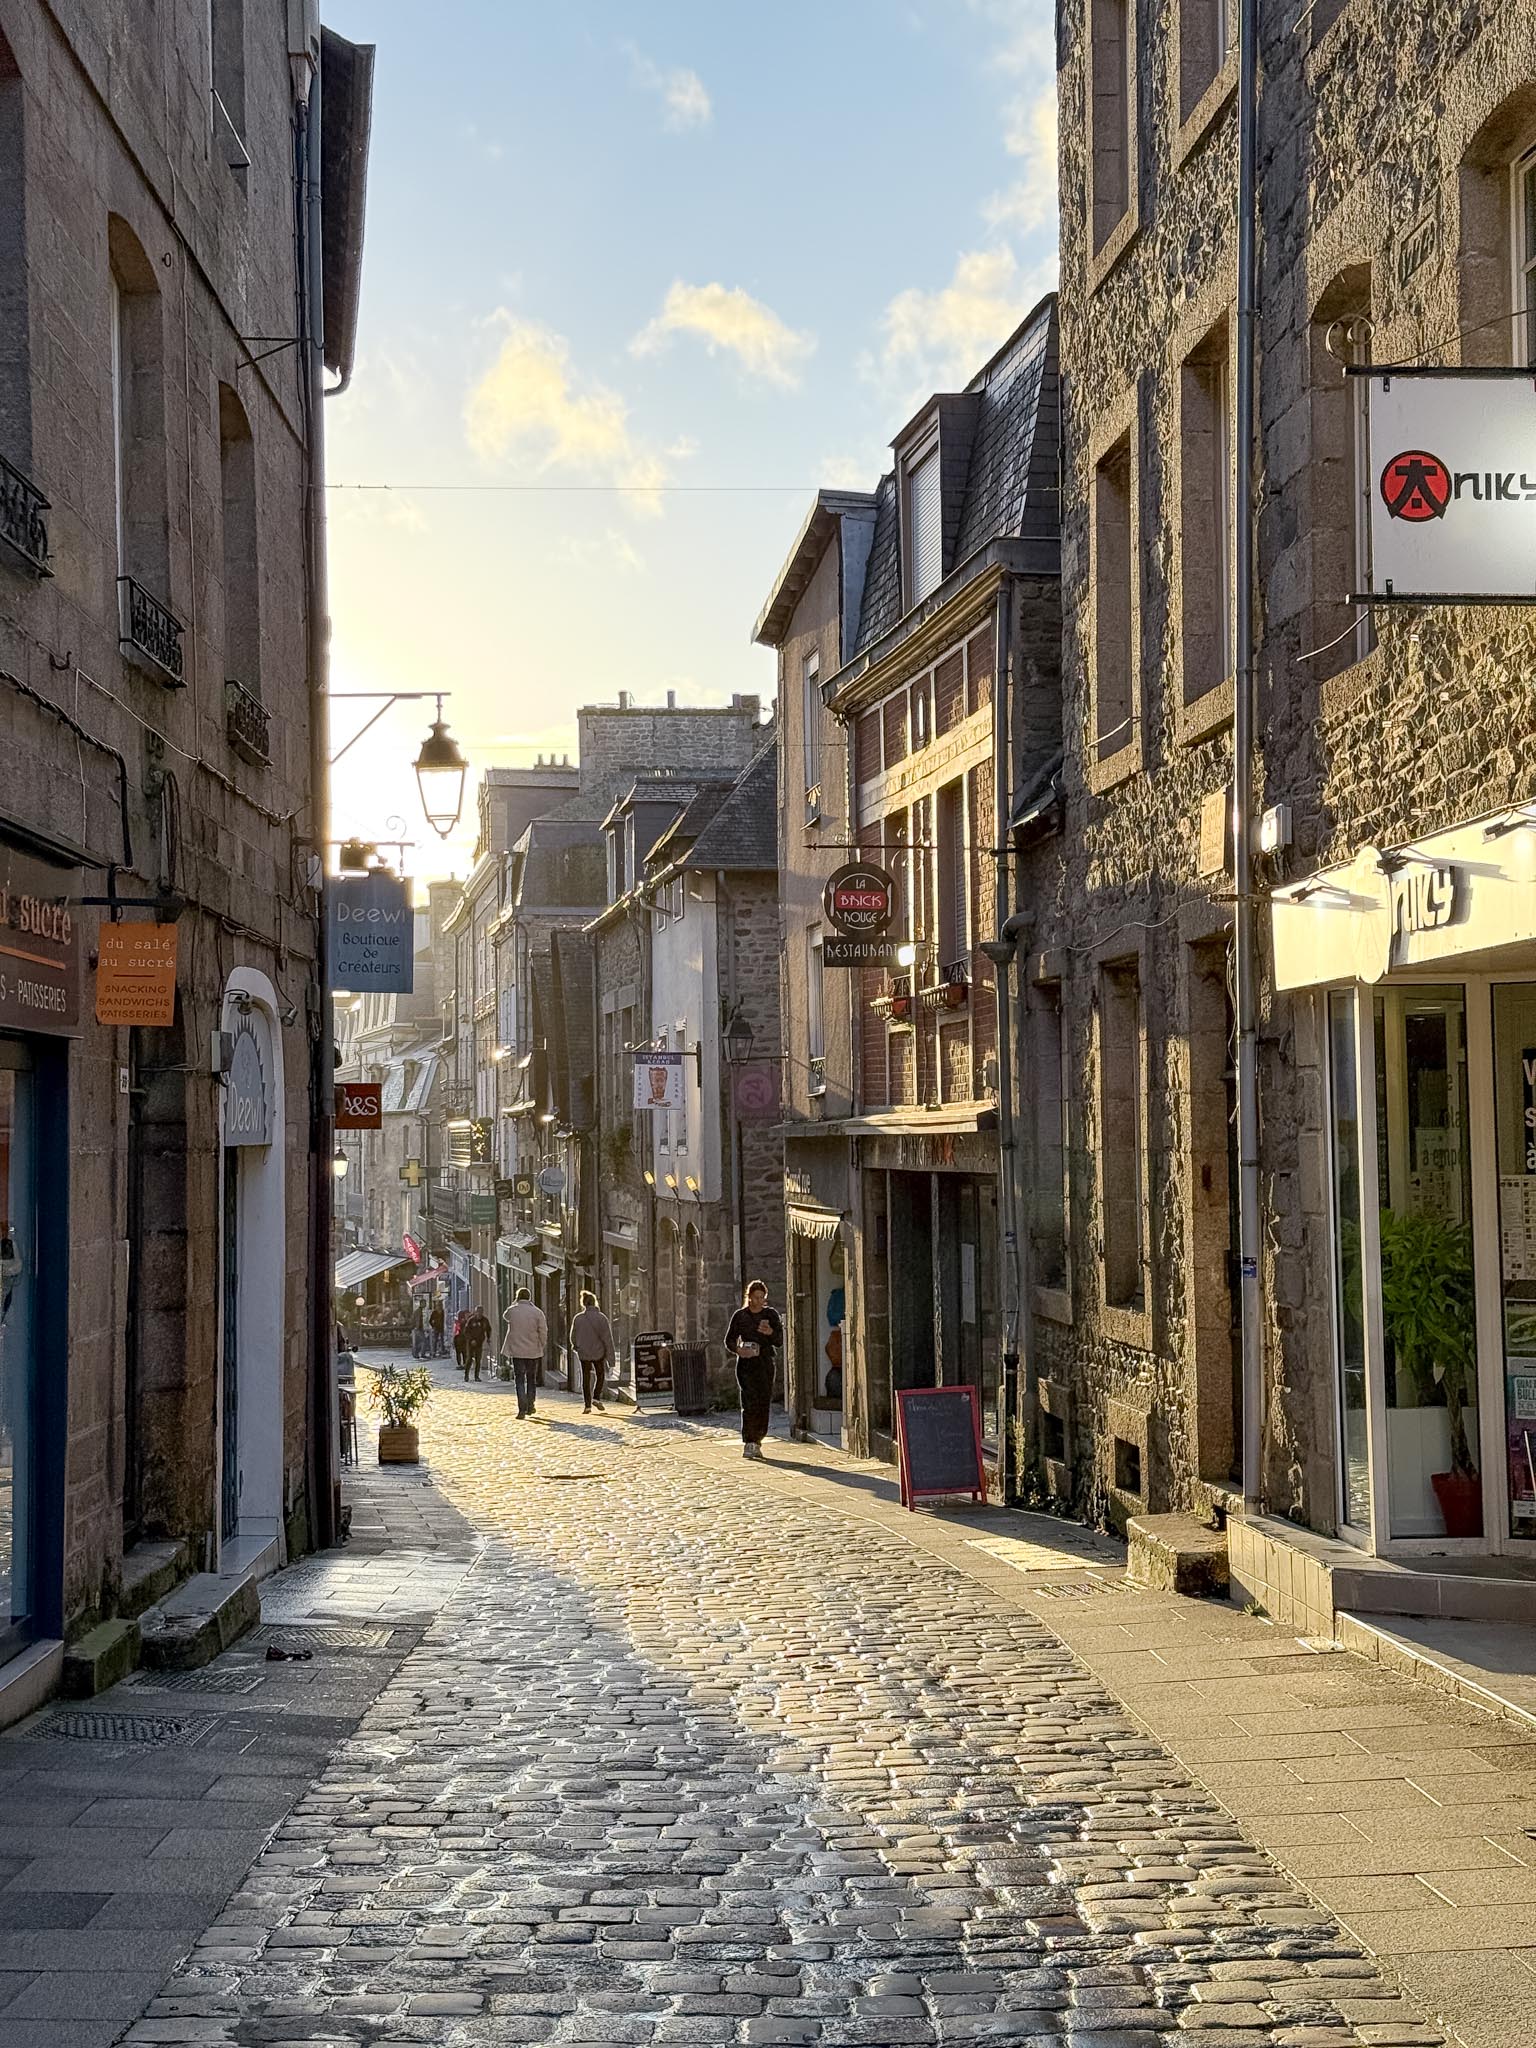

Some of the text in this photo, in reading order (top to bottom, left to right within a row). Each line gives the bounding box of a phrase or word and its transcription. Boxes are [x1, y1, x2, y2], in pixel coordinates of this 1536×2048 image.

[855, 879, 866, 889] LA
[840, 895, 882, 907] BRICK
[337, 902, 406, 923] Deewi
[844, 911, 877, 923] ROUGE
[20, 894, 72, 946] sucré
[106, 938, 170, 950] du salé
[342, 932, 400, 946] Boutique
[363, 948, 378, 958] de
[827, 943, 898, 958] RESTAURANT
[100, 957, 174, 968] au sucré
[338, 960, 400, 974] Créateurs
[18, 979, 67, 1012] PATISSERIES
[104, 985, 167, 994] SNACKING
[98, 998, 170, 1007] SANDWICHS
[100, 1010, 167, 1019] PATISSERIES
